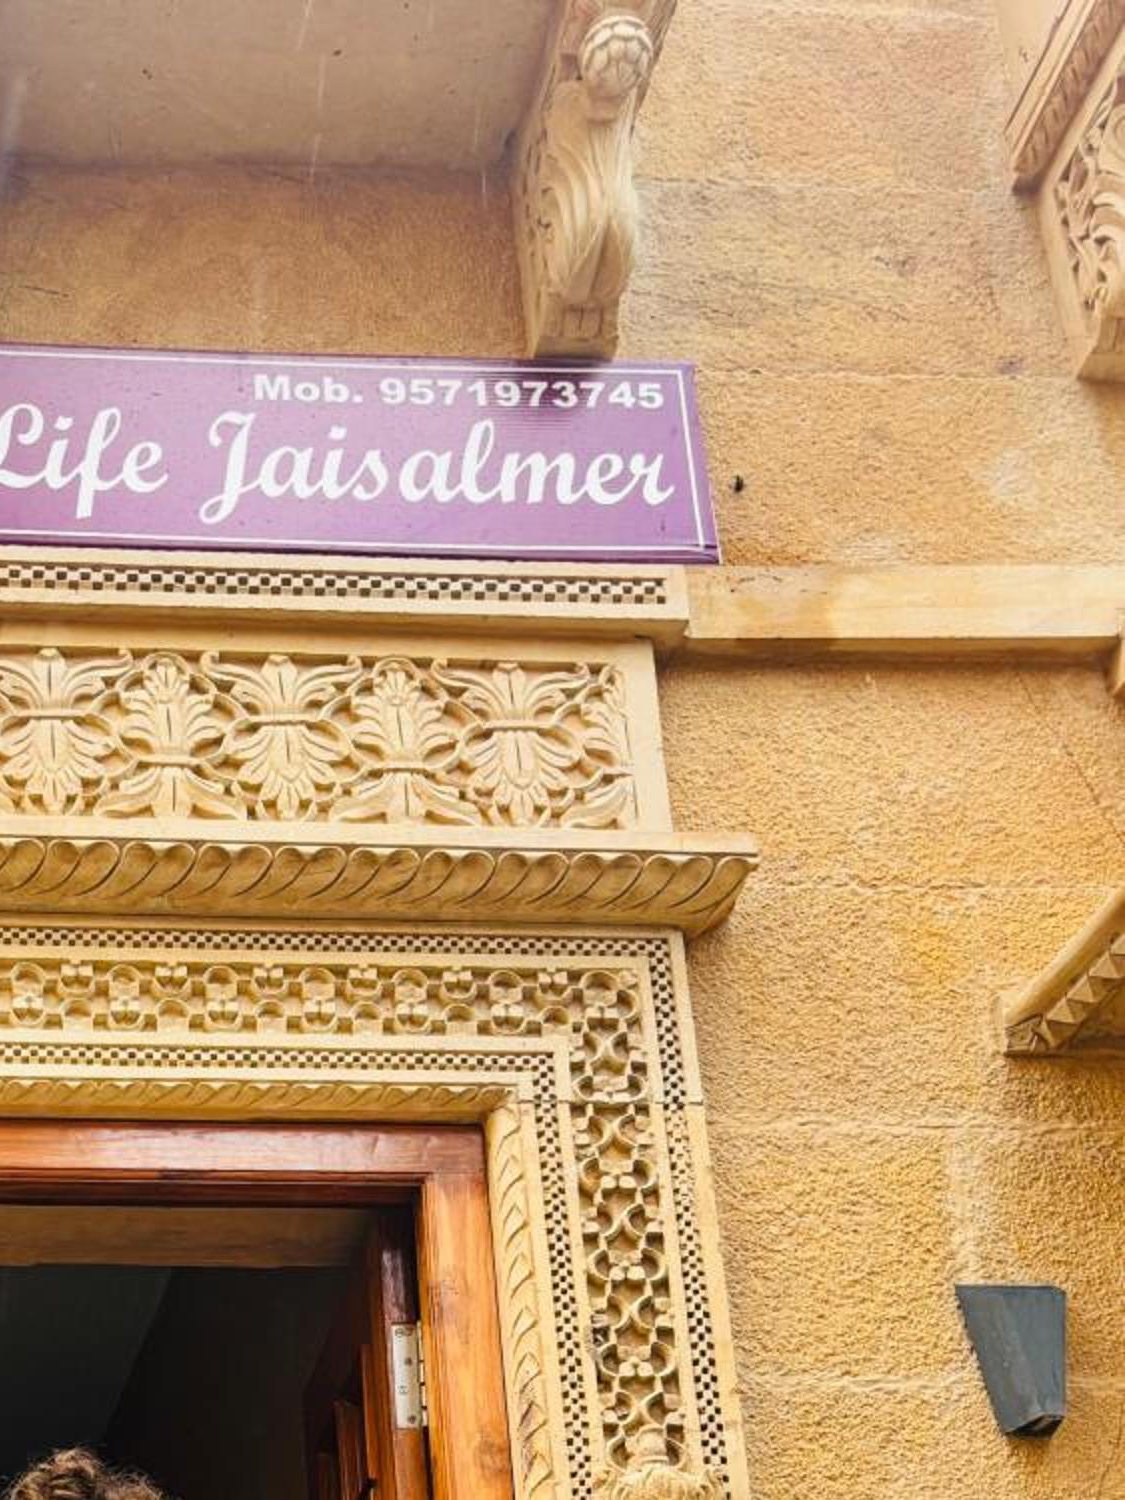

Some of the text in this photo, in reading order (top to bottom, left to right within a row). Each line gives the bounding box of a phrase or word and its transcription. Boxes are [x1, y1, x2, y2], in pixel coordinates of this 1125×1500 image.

[253, 374, 665, 409] Mob. 9571973745
[198, 410, 676, 525] Jaisalmer
